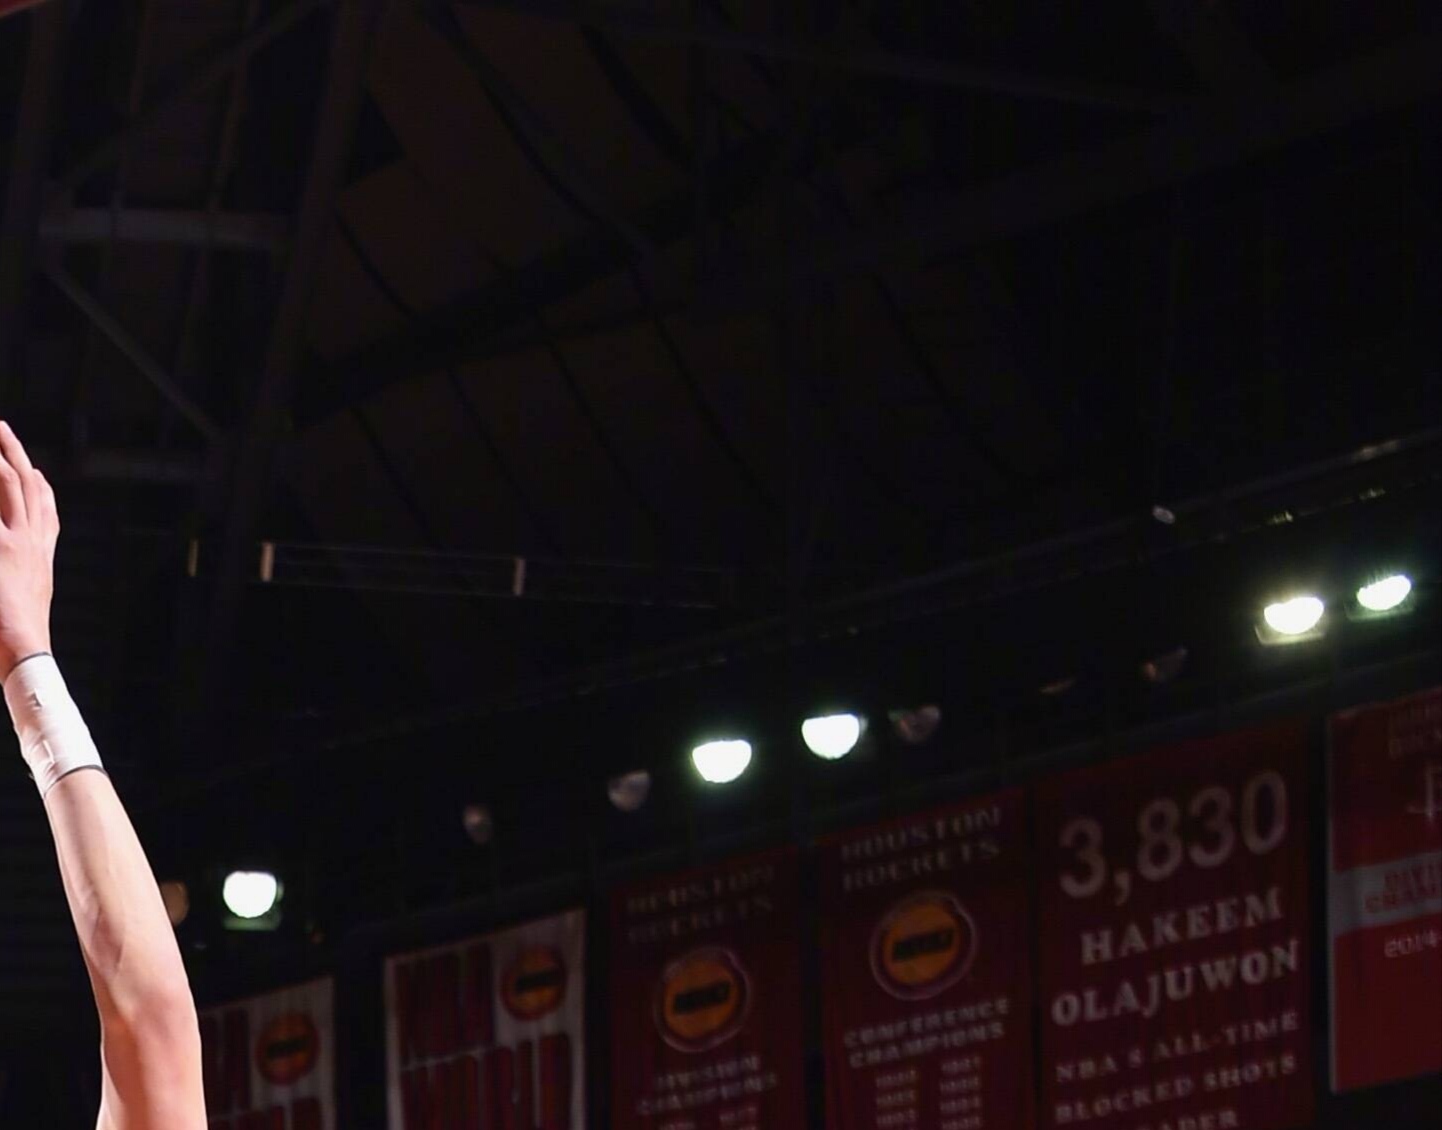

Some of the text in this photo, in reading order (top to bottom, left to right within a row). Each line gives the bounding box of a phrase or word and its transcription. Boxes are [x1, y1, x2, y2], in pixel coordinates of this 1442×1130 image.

[1059, 770, 1289, 906] 3,830
[1081, 886, 1284, 966] HAKEEM
[1051, 937, 1300, 1027] OLAJUWON
[1055, 1051, 1297, 1123] BLOCKED SHOTS
